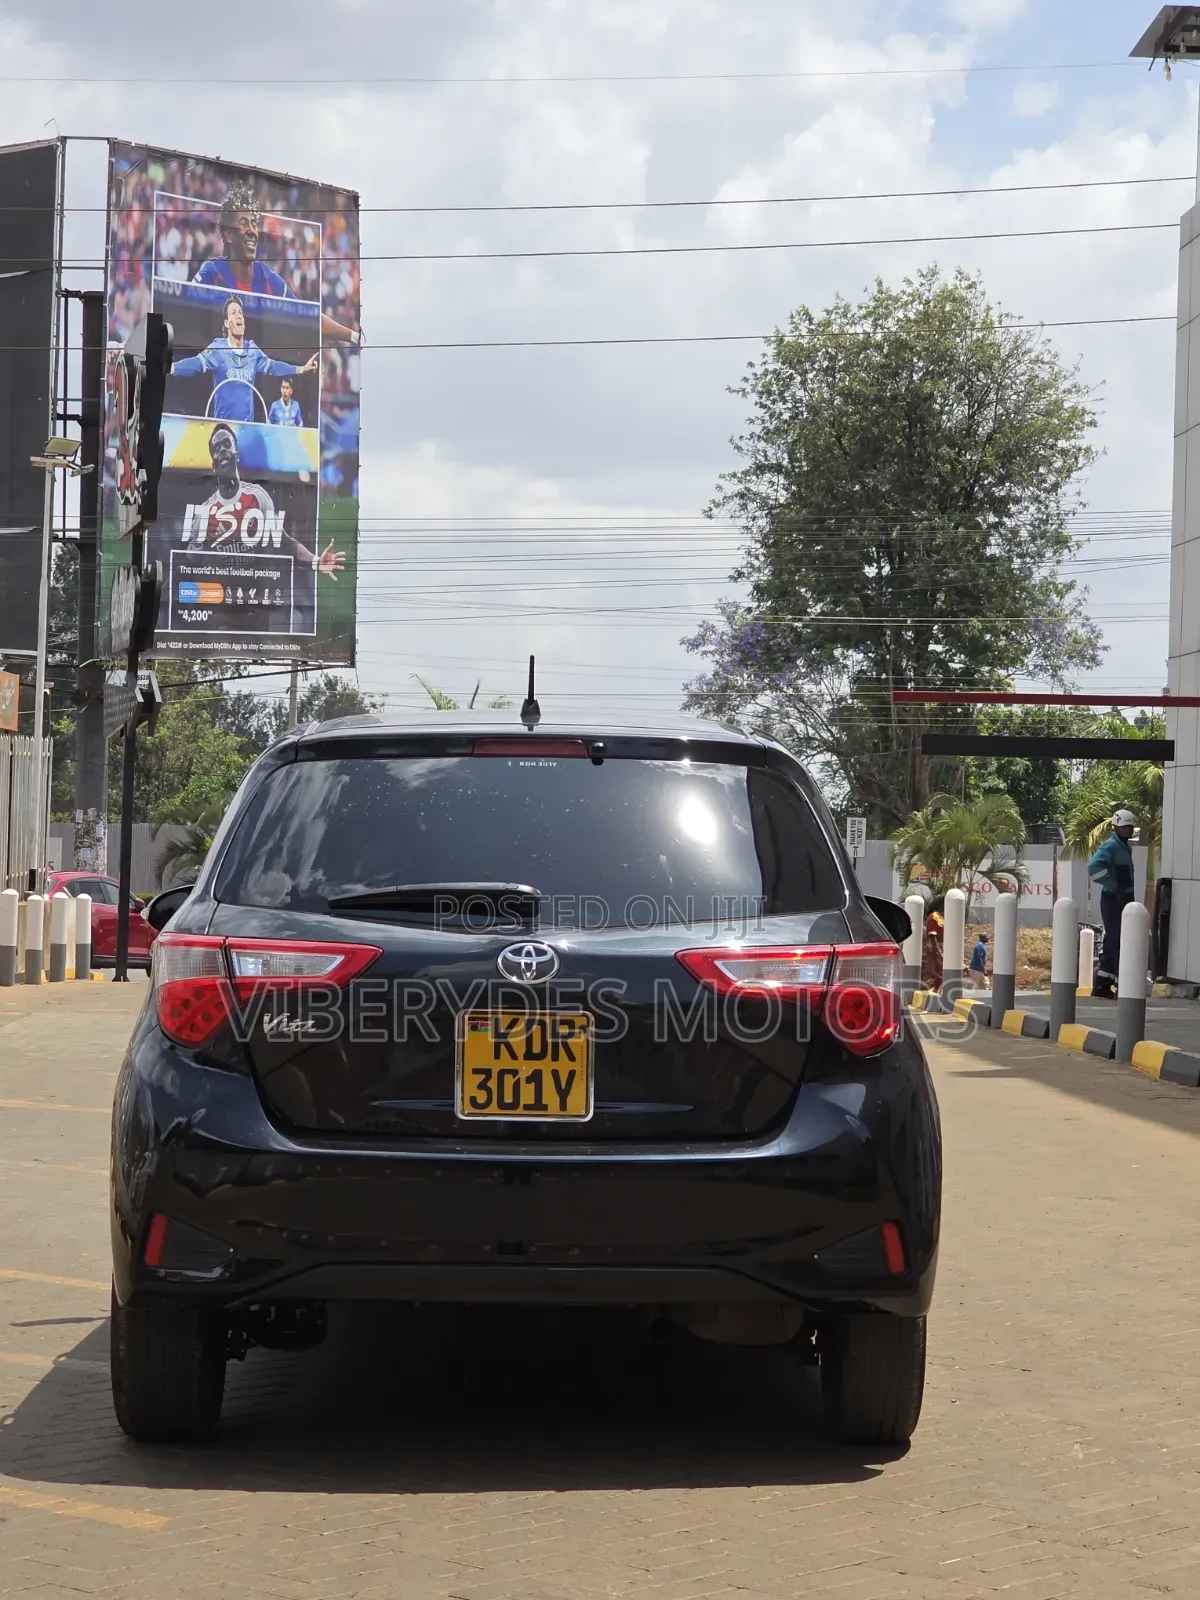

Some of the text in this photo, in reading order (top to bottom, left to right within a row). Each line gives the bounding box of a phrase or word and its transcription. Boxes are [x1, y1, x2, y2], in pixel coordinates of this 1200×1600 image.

[241, 508, 286, 548] ON
[179, 565, 281, 580] The world's best football package
[182, 609, 208, 622] 4,200
[156, 641, 167, 649] Dial
[232, 643, 242, 651] App
[259, 643, 284, 651] Connected
[262, 1012, 317, 1034] Vitz
[493, 1017, 577, 1062] KDR
[469, 1067, 577, 1112] 301Y
